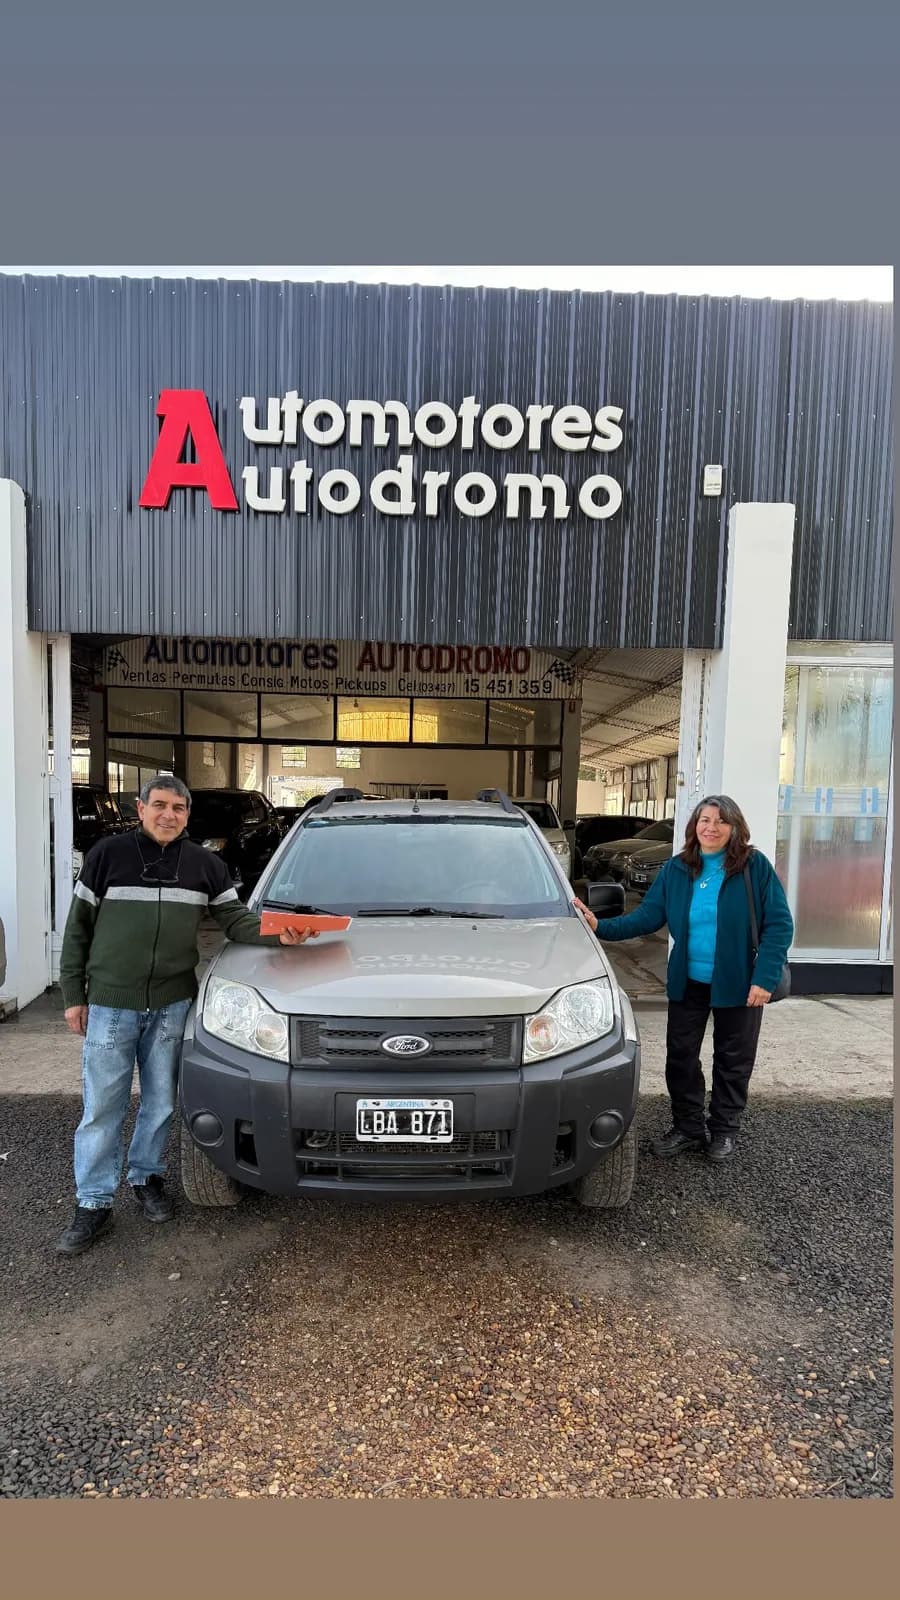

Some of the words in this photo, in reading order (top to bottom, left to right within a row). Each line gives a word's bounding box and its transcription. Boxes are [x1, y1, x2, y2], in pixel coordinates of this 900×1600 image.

[143, 636, 339, 670] Automotores
[357, 641, 531, 674] AUTODROMO
[121, 669, 167, 683] Ventas
[172, 671, 236, 687] Permutas
[290, 676, 329, 690] Motos
[335, 678, 387, 692] Pickups
[463, 679, 480, 693] 15
[486, 680, 513, 694] 451
[518, 680, 552, 695] 359
[386, 1100, 425, 1108] ARGENTINA
[360, 1111, 399, 1134] LBA
[411, 1111, 449, 1134] 871
